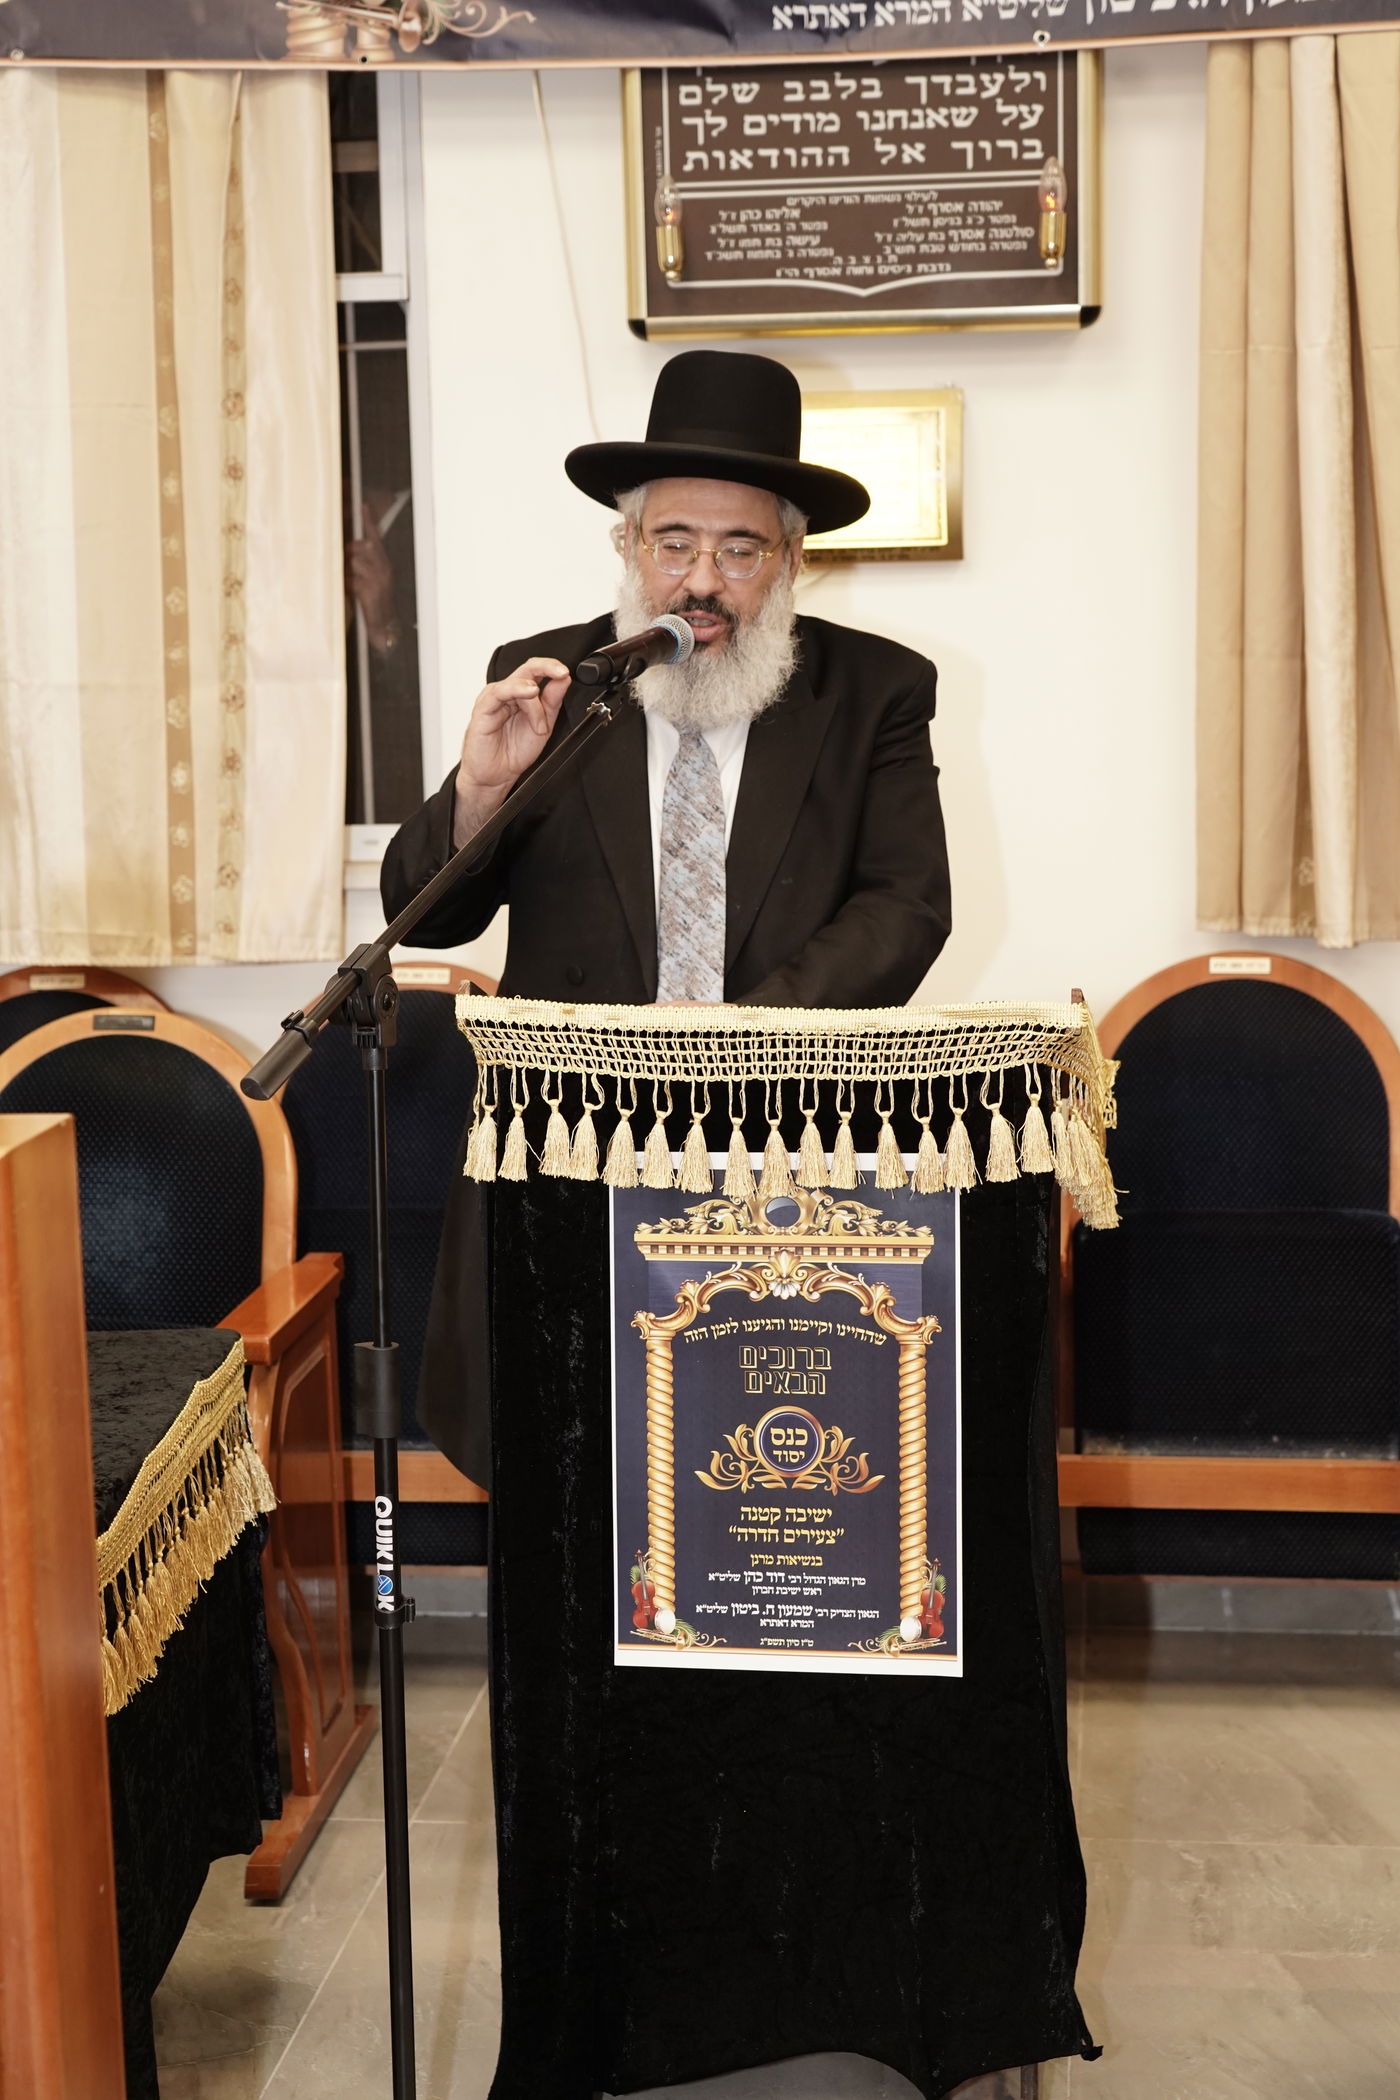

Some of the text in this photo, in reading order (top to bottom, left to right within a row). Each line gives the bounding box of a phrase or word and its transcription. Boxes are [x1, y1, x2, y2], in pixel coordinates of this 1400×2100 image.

[772, 3, 868, 31] דאתרא
[873, 0, 952, 27] המרא
[678, 77, 761, 106] שלם
[783, 72, 883, 102] בלבב
[904, 65, 1048, 104] ולעבדך
[681, 99, 1045, 145] על שאנחנו מודים לך
[682, 144, 850, 172] ההודאות
[873, 137, 927, 165] אל
[950, 137, 1046, 170] ברוך
[683, 1316, 888, 1346] שהחיינו וקיימנו והגיענו לזמן הזה
[738, 1345, 832, 1370] ברוכים
[744, 1370, 826, 1395] הבאים
[769, 1427, 809, 1447] כנס
[772, 1449, 806, 1464] יסוד
[740, 1505, 833, 1525] ישיבה קטנה
[750, 1553, 824, 1568] בנשיאות מרנן
[743, 1570, 764, 1585] כהן
[766, 1571, 786, 1583] דוד
[787, 1574, 802, 1584] רבי
[850, 1576, 867, 1587] מרן
[751, 1585, 822, 1596] ראש ישיבת חברון
[730, 1602, 760, 1618] ביטון
[777, 1604, 813, 1619] שמעון
[814, 1608, 829, 1617] רבי
[830, 1608, 857, 1620] הצדיק
[759, 1618, 815, 1629] המרא דאתרא
